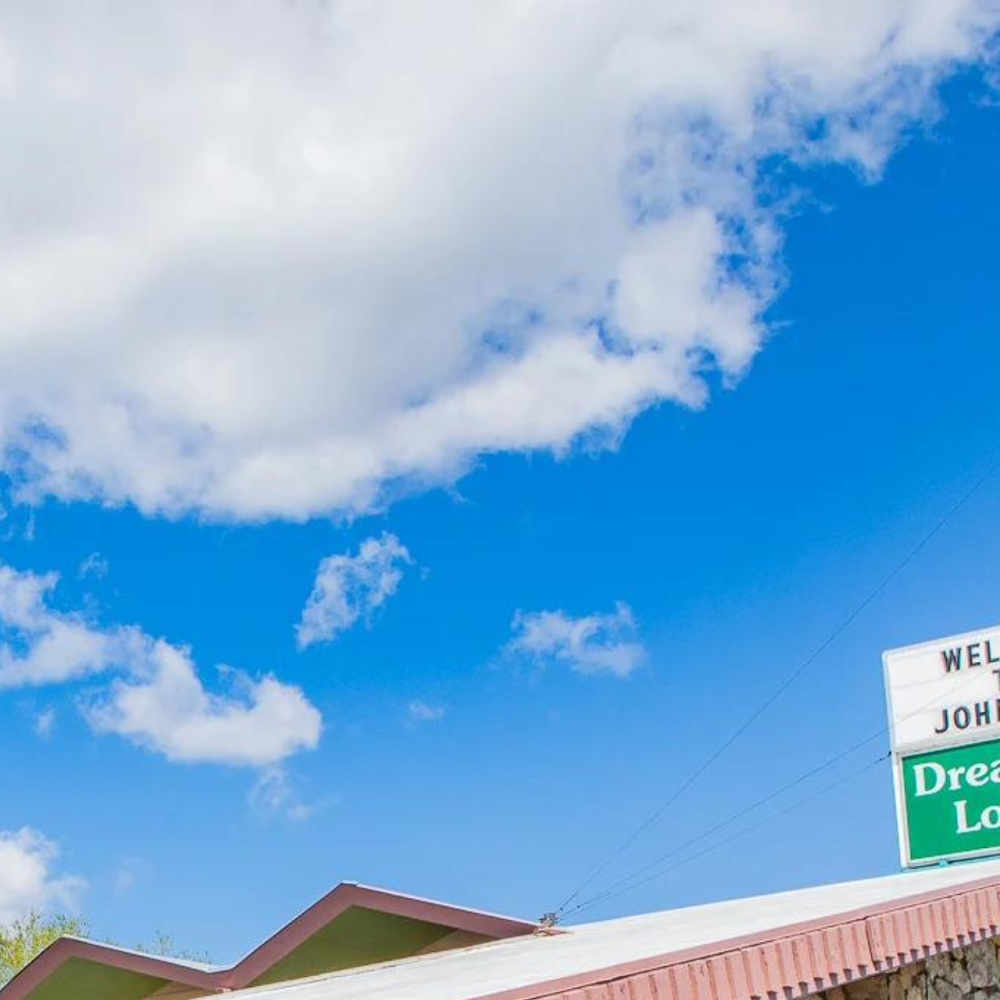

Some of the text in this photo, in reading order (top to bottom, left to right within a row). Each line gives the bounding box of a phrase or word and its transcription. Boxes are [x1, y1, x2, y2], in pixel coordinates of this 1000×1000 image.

[940, 640, 1000, 673] WEL
[934, 698, 1000, 734] JOH
[953, 799, 1000, 834] Lo
